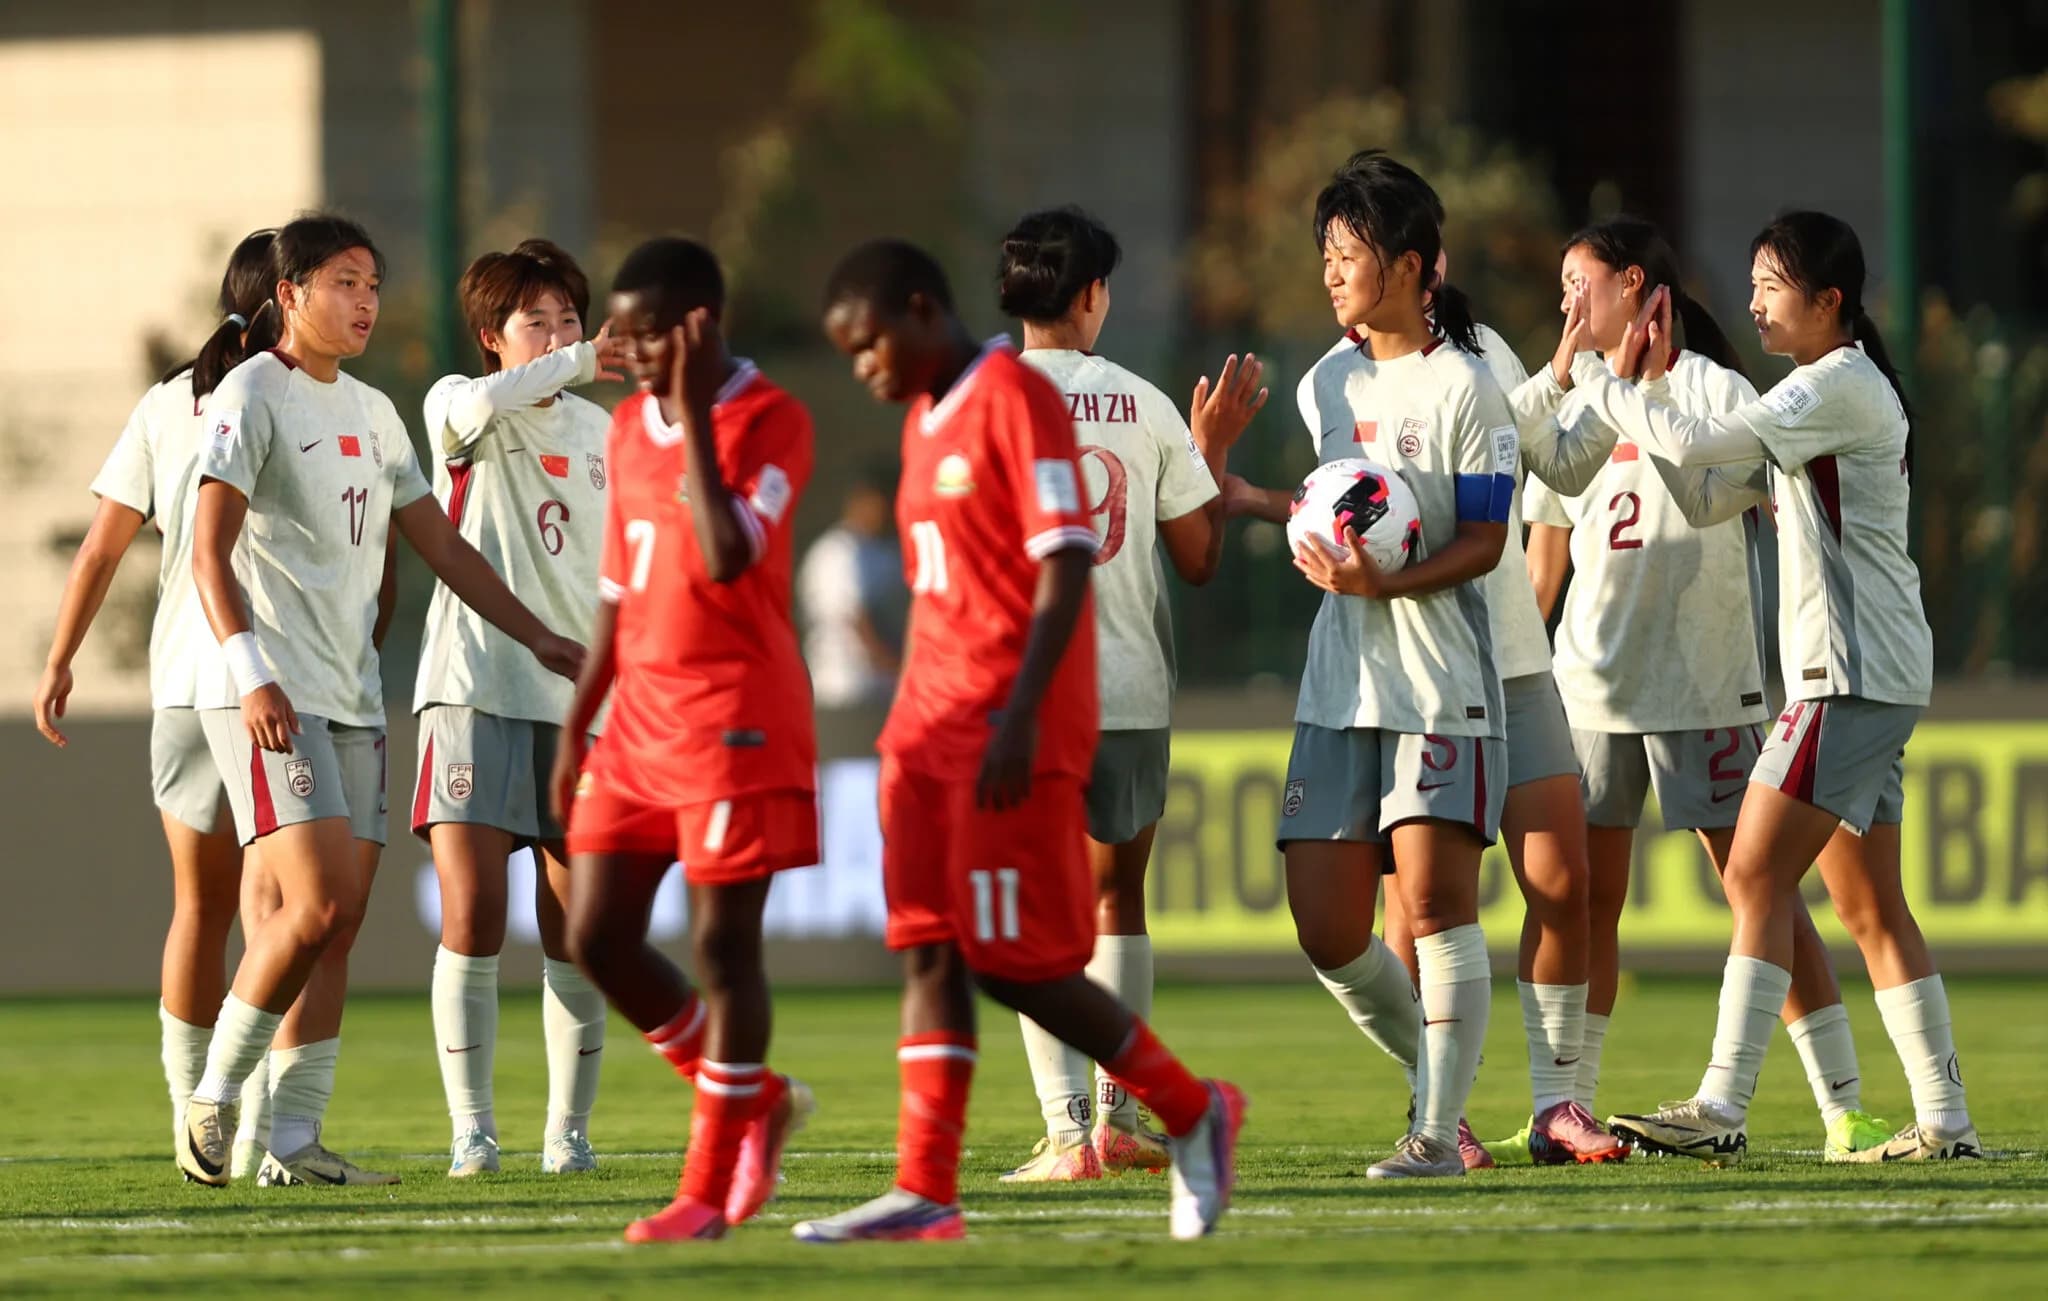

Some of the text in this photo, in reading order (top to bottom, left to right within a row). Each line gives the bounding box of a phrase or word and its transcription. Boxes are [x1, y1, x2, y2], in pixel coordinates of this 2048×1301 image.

[1067, 393, 1137, 423] ZH ZH
[341, 486, 368, 546] 11
[537, 500, 570, 556] 6
[1609, 491, 1643, 550] 2
[626, 520, 655, 592] 7
[910, 520, 947, 592] 11
[1778, 702, 1806, 743] 4
[1704, 727, 1744, 782] 2
[969, 868, 1020, 942] 11
